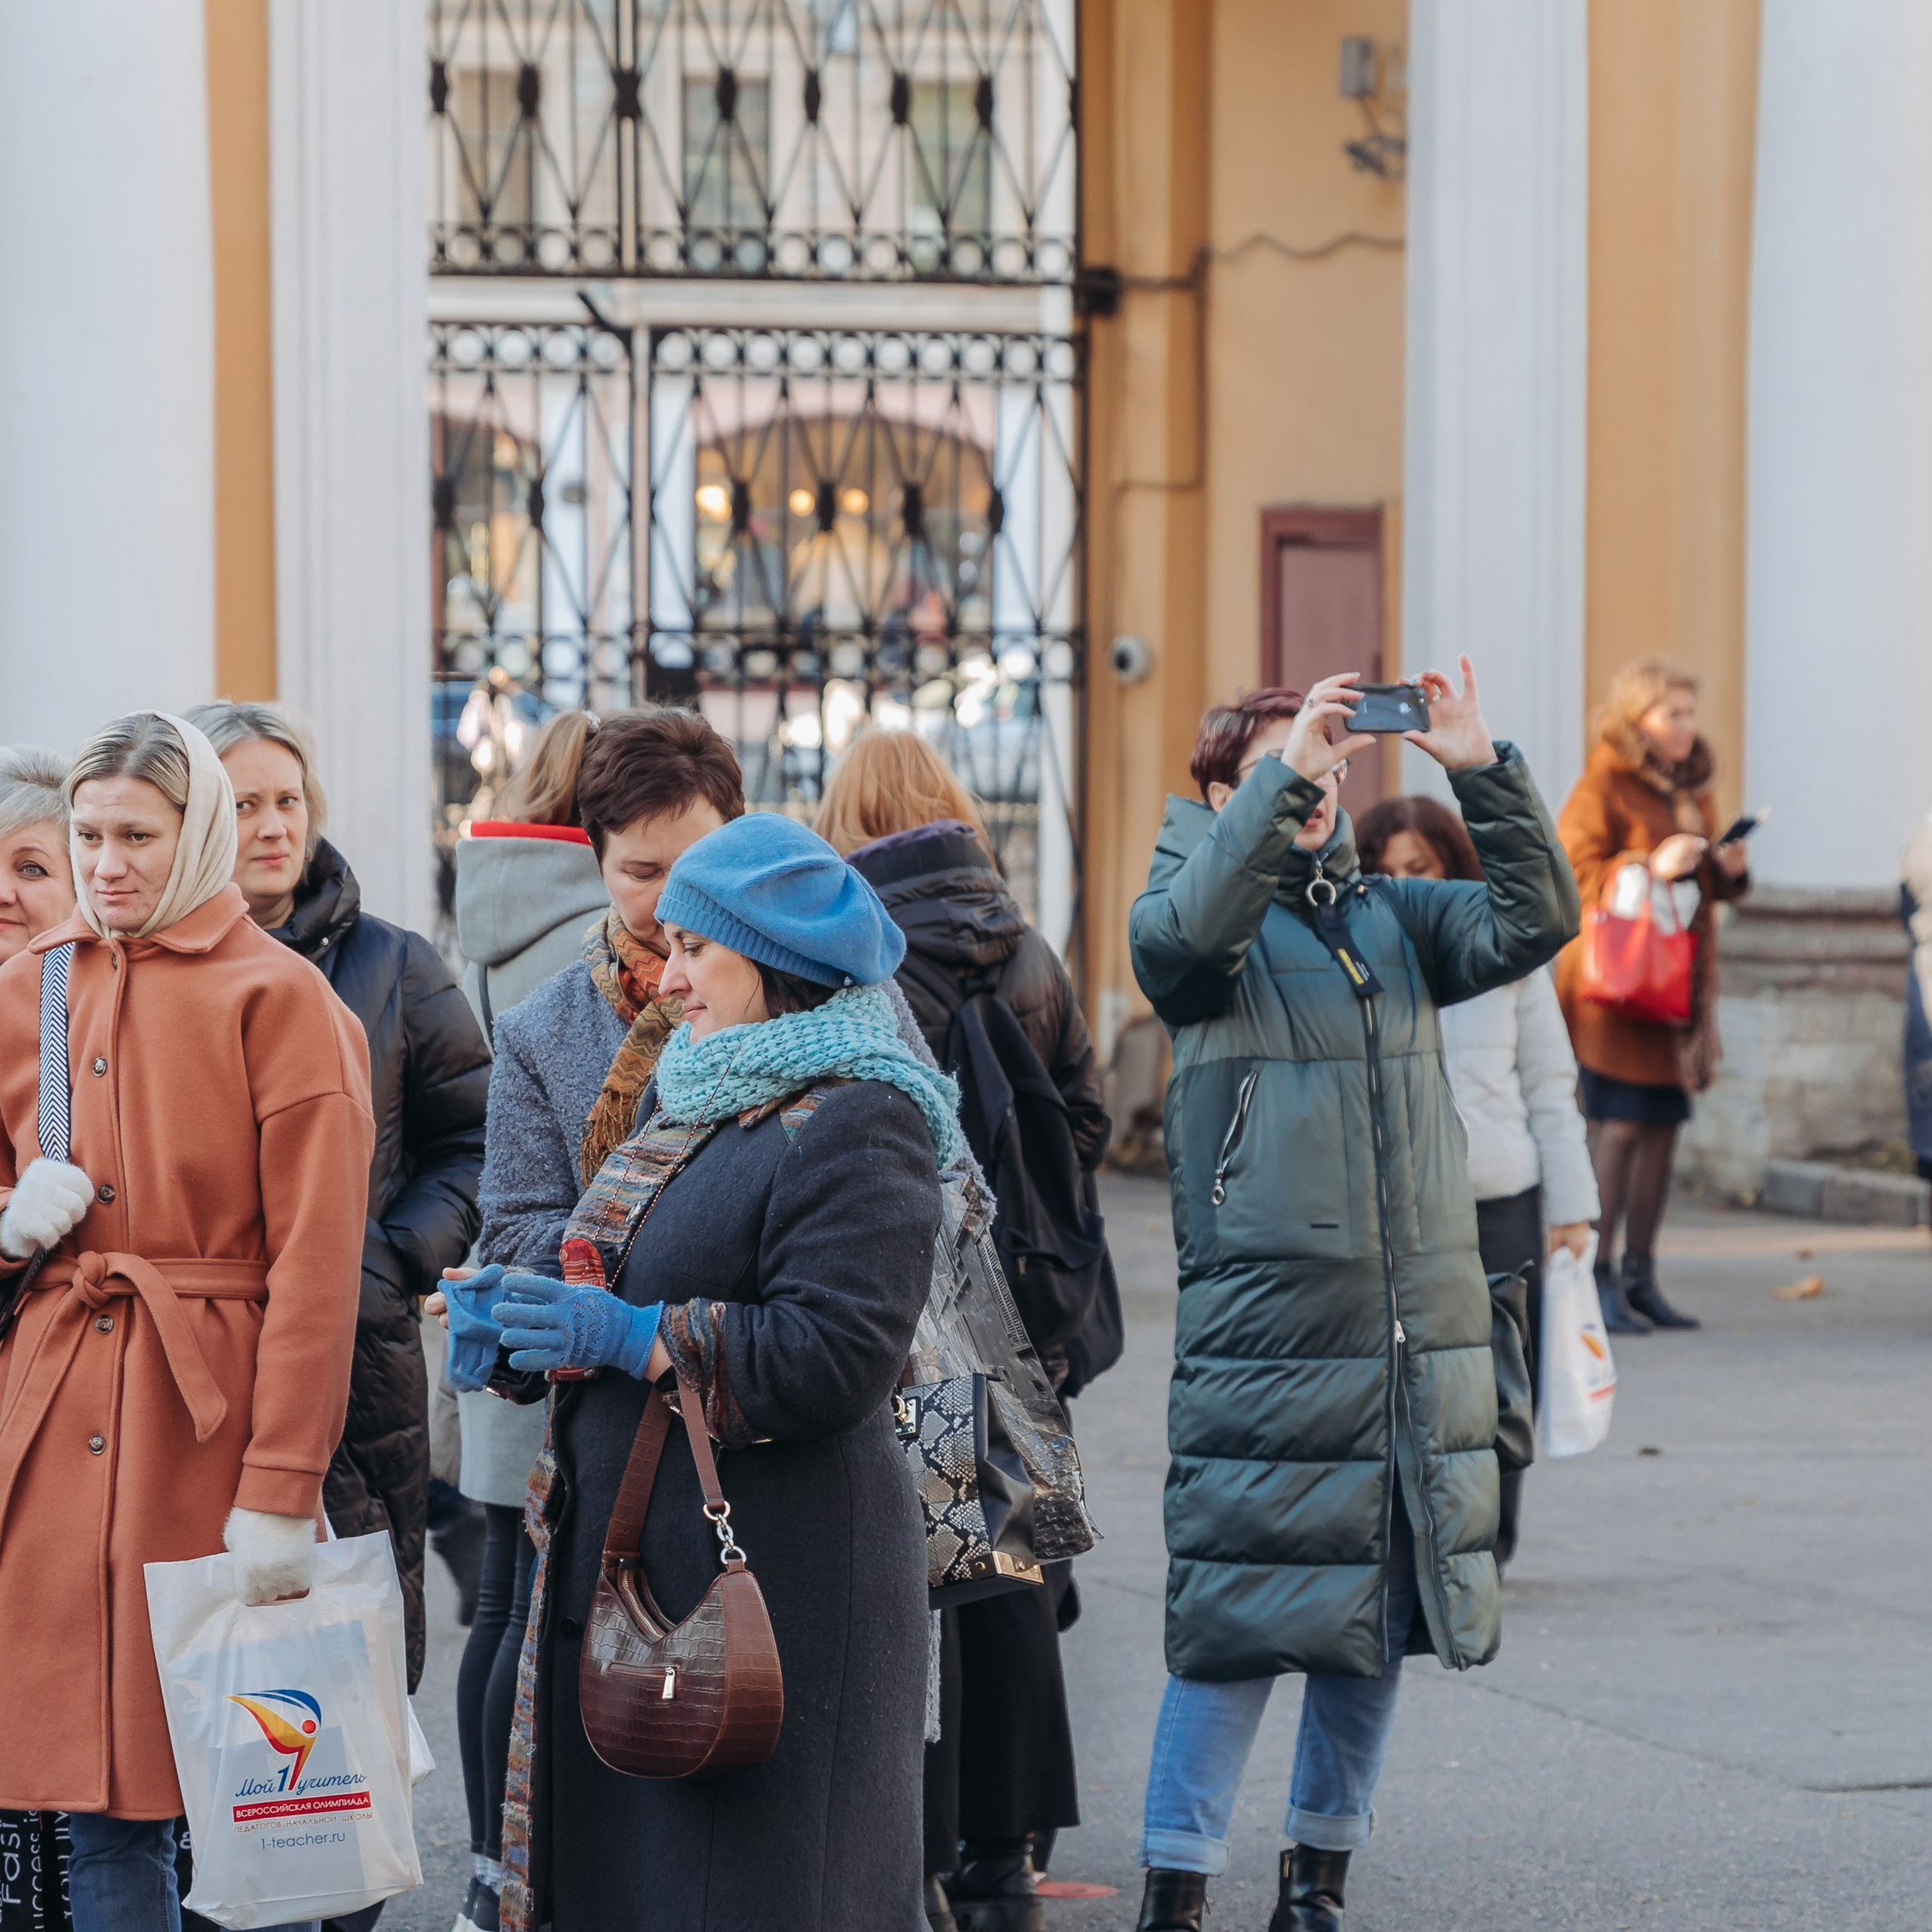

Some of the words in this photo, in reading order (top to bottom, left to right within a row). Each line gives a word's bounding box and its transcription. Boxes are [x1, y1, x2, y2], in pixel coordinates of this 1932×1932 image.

[235, 1778, 276, 1797] Мой
[277, 1764, 291, 1792] 1
[296, 1774, 367, 1795] учитель
[235, 1801, 312, 1818] ВСЕРОССИЙСКАЯ
[312, 1797, 369, 1810] ОЛИМПИАДА
[234, 1821, 282, 1833] ПЕДАГОГОВ
[285, 1815, 337, 1828] НАЧАЛЬНОЙ
[342, 1812, 373, 1823] ШКОЛЫ
[261, 1832, 346, 1850] 1-teacher.ru
